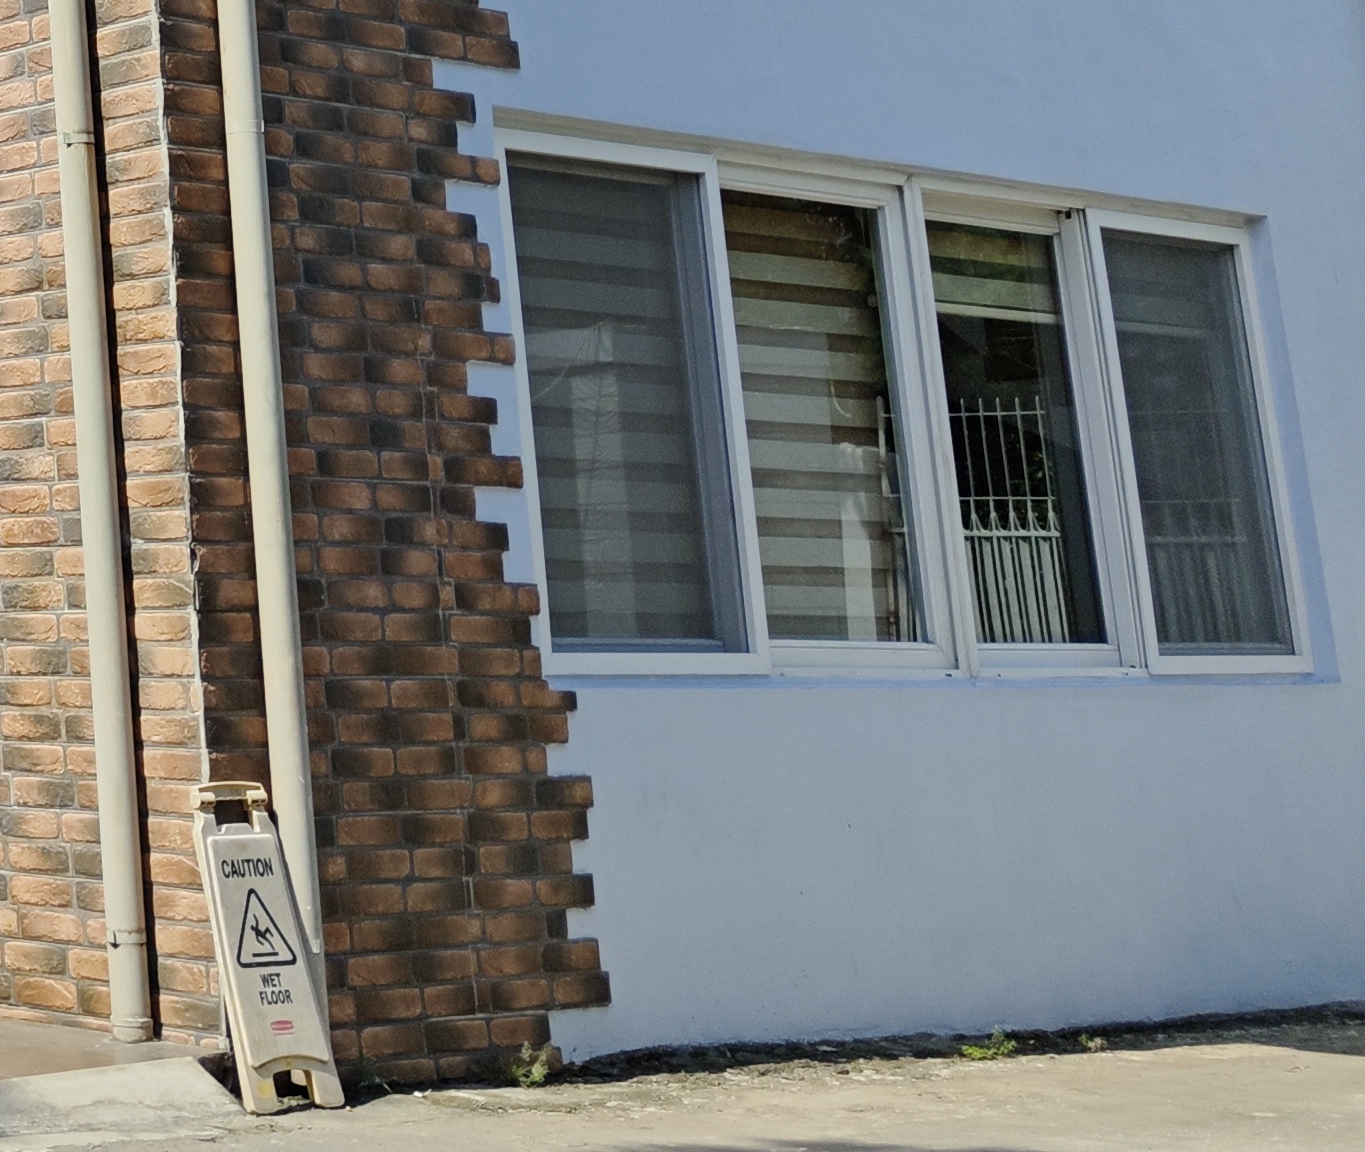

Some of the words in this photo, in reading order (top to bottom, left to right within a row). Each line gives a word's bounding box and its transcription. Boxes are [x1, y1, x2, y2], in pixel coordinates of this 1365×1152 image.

[221, 857, 274, 879] CAUTION
[259, 972, 282, 989] WET
[258, 989, 294, 1006] FLOOR
